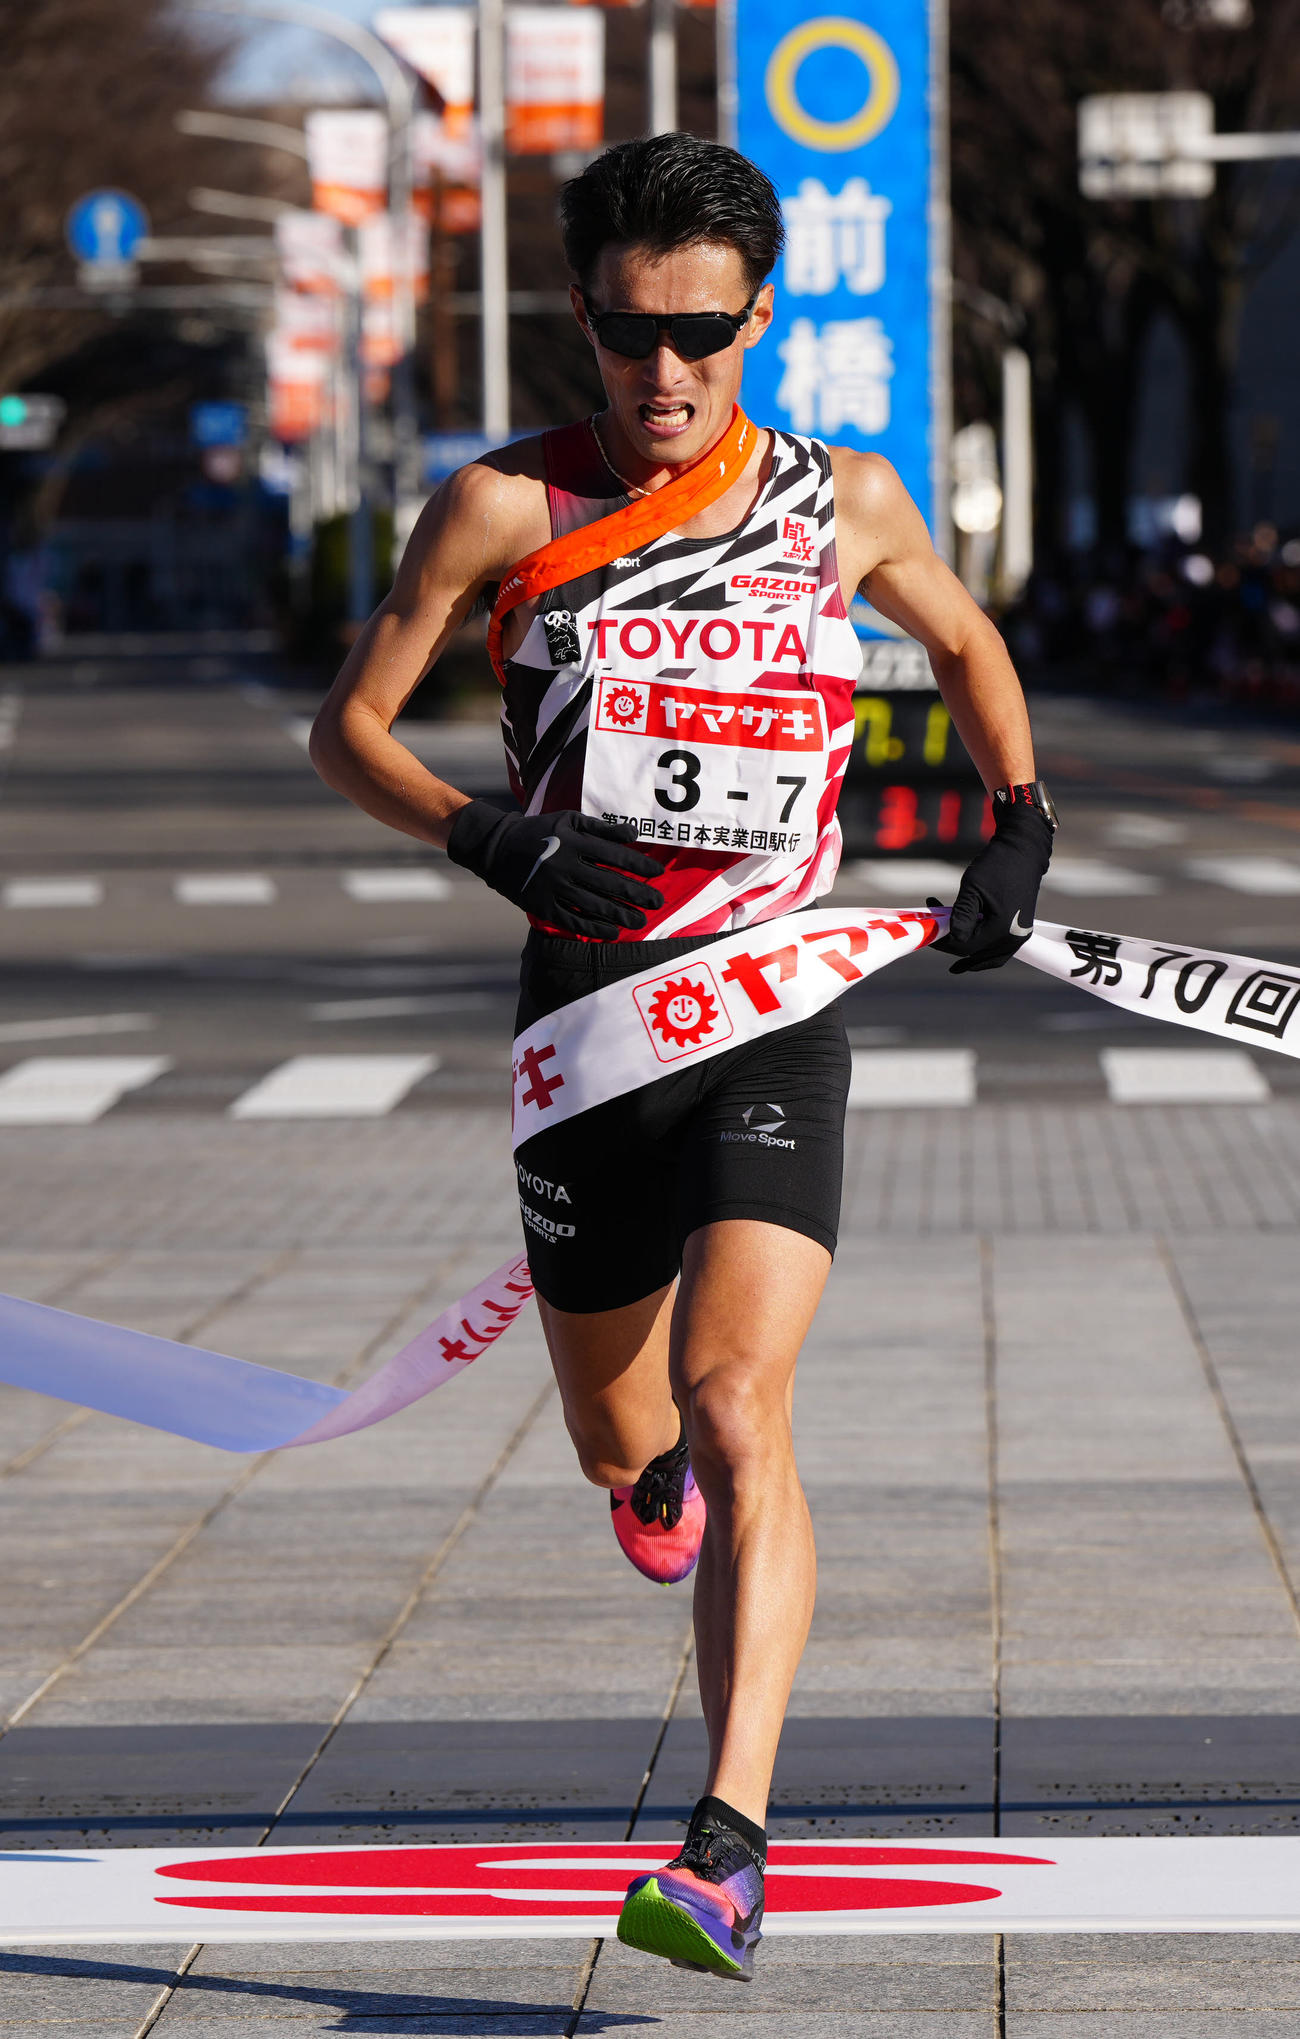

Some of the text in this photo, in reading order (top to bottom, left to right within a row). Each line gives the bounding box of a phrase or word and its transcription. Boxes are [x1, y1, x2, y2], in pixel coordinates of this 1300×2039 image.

[777, 177, 895, 436] 前橋
[730, 574, 817, 595] GAZOO
[748, 589, 802, 601] SPORTS
[587, 617, 808, 665] TOYOTA
[659, 696, 815, 740] ヤマザキ
[654, 749, 702, 813] 3
[776, 775, 807, 824] 7
[516, 1160, 573, 1205] OYOTA
